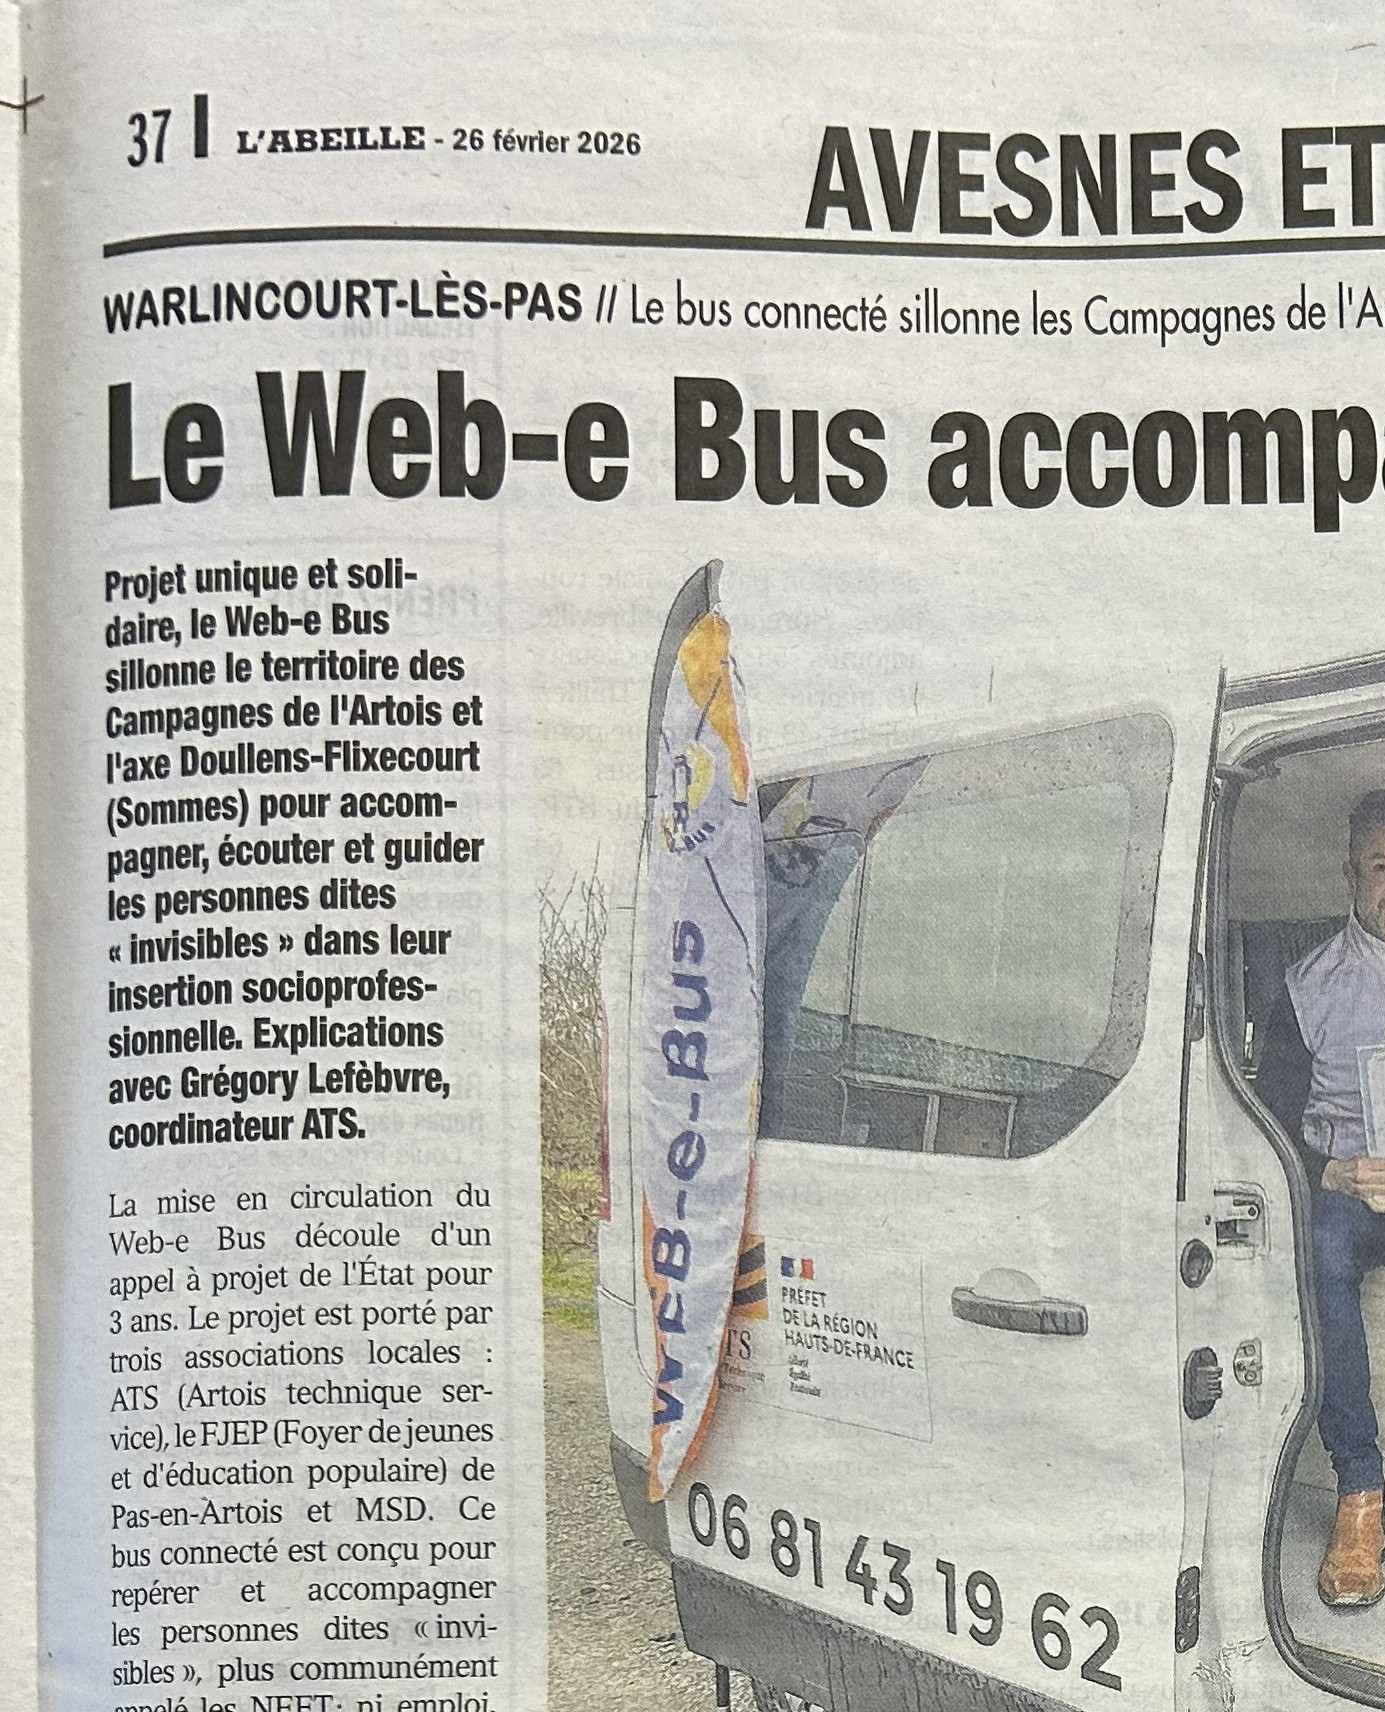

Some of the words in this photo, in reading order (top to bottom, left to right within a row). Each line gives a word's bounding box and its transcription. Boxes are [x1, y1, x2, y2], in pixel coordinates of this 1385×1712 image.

[126, 108, 172, 168] 37
[236, 125, 426, 155] L'ABEILLE
[452, 127, 485, 152] 26
[492, 127, 571, 154] février
[577, 130, 642, 156] 2026
[804, 125, 1244, 238] AVESNES
[103, 269, 583, 335] WARLINCOURT-LÈS-PAS
[631, 283, 664, 325] Le
[676, 278, 732, 327] bus
[744, 293, 888, 333] connecté
[899, 287, 1020, 336] sillonne
[1032, 289, 1073, 336] les
[1083, 294, 1276, 348] Campagnes
[1286, 282, 1326, 331] de
[107, 381, 225, 511] Le
[254, 369, 630, 503] Web-e
[673, 375, 888, 509] Bus
[105, 563, 187, 605] Projet
[195, 559, 299, 599] unique
[307, 557, 339, 590] et
[347, 557, 418, 590] soli-
[105, 611, 182, 649] daire,
[190, 607, 217, 640] le
[224, 603, 322, 638] Web-e
[331, 602, 390, 636] Bus
[105, 657, 216, 694] sillonne
[225, 651, 253, 684] le
[260, 648, 400, 683] territoire
[409, 648, 466, 682] des
[106, 751, 171, 785] l'axe
[180, 739, 481, 778] Doullens-Flixecourt
[108, 973, 233, 1013] insertion
[241, 968, 438, 1009] socioprofes-
[108, 1019, 243, 1059] sionnelle.
[253, 1015, 444, 1056] Explications
[108, 1074, 172, 1105] avec
[180, 1063, 299, 1104] Grégory
[308, 1059, 451, 1100] Lefèbvre,
[108, 1110, 295, 1151] coordinateur
[301, 1106, 366, 1140] ATS.
[108, 1193, 138, 1219] La
[156, 1188, 216, 1215] mise
[236, 1191, 268, 1212] en
[290, 1182, 433, 1210] circulation
[456, 1181, 491, 1208] du
[781, 1285, 827, 1309] PRÉFET
[783, 1307, 801, 1326] DE
[803, 1311, 819, 1331] LA
[823, 1312, 878, 1340] RÉGION
[784, 1329, 915, 1370] HAUTS-DE-FRANCE
[688, 1482, 751, 1560] 06
[770, 1509, 824, 1588] 81
[845, 1535, 914, 1616] 43
[936, 1558, 1003, 1646] 19
[1031, 1592, 1122, 1692] 62
